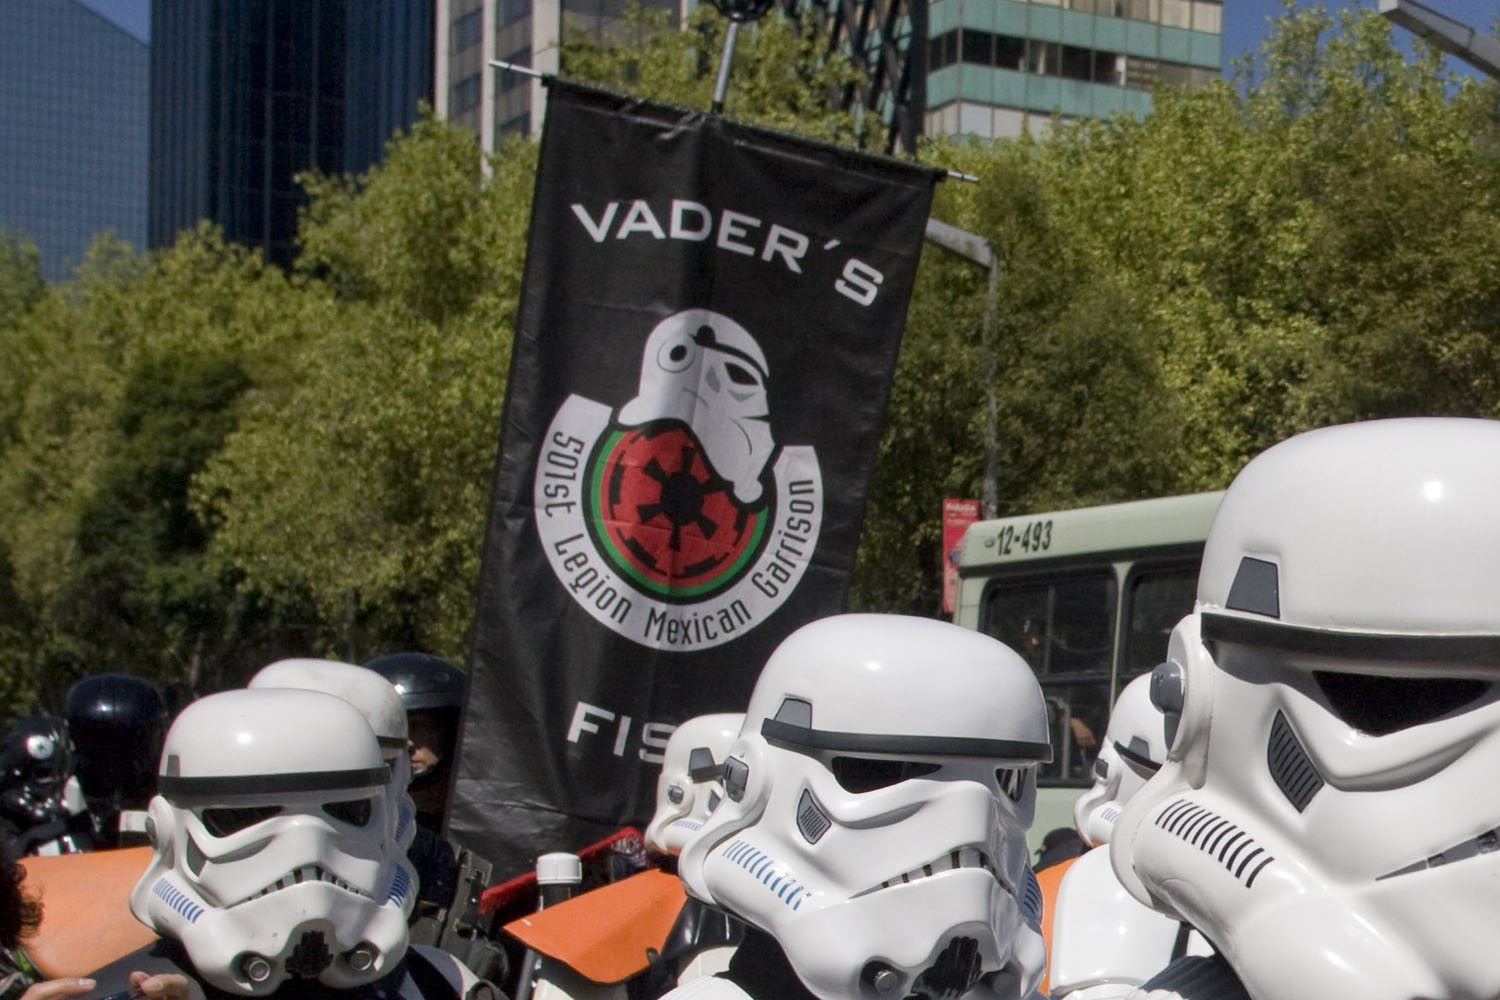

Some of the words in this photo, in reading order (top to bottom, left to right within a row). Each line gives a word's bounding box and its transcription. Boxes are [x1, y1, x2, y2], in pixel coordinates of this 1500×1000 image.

[544, 431, 585, 518] 501st
[751, 479, 815, 600] Garrison
[997, 519, 1054, 557] 12-493
[554, 533, 632, 623] Legion
[644, 598, 753, 646] Mexican
[566, 701, 678, 764] FIS
